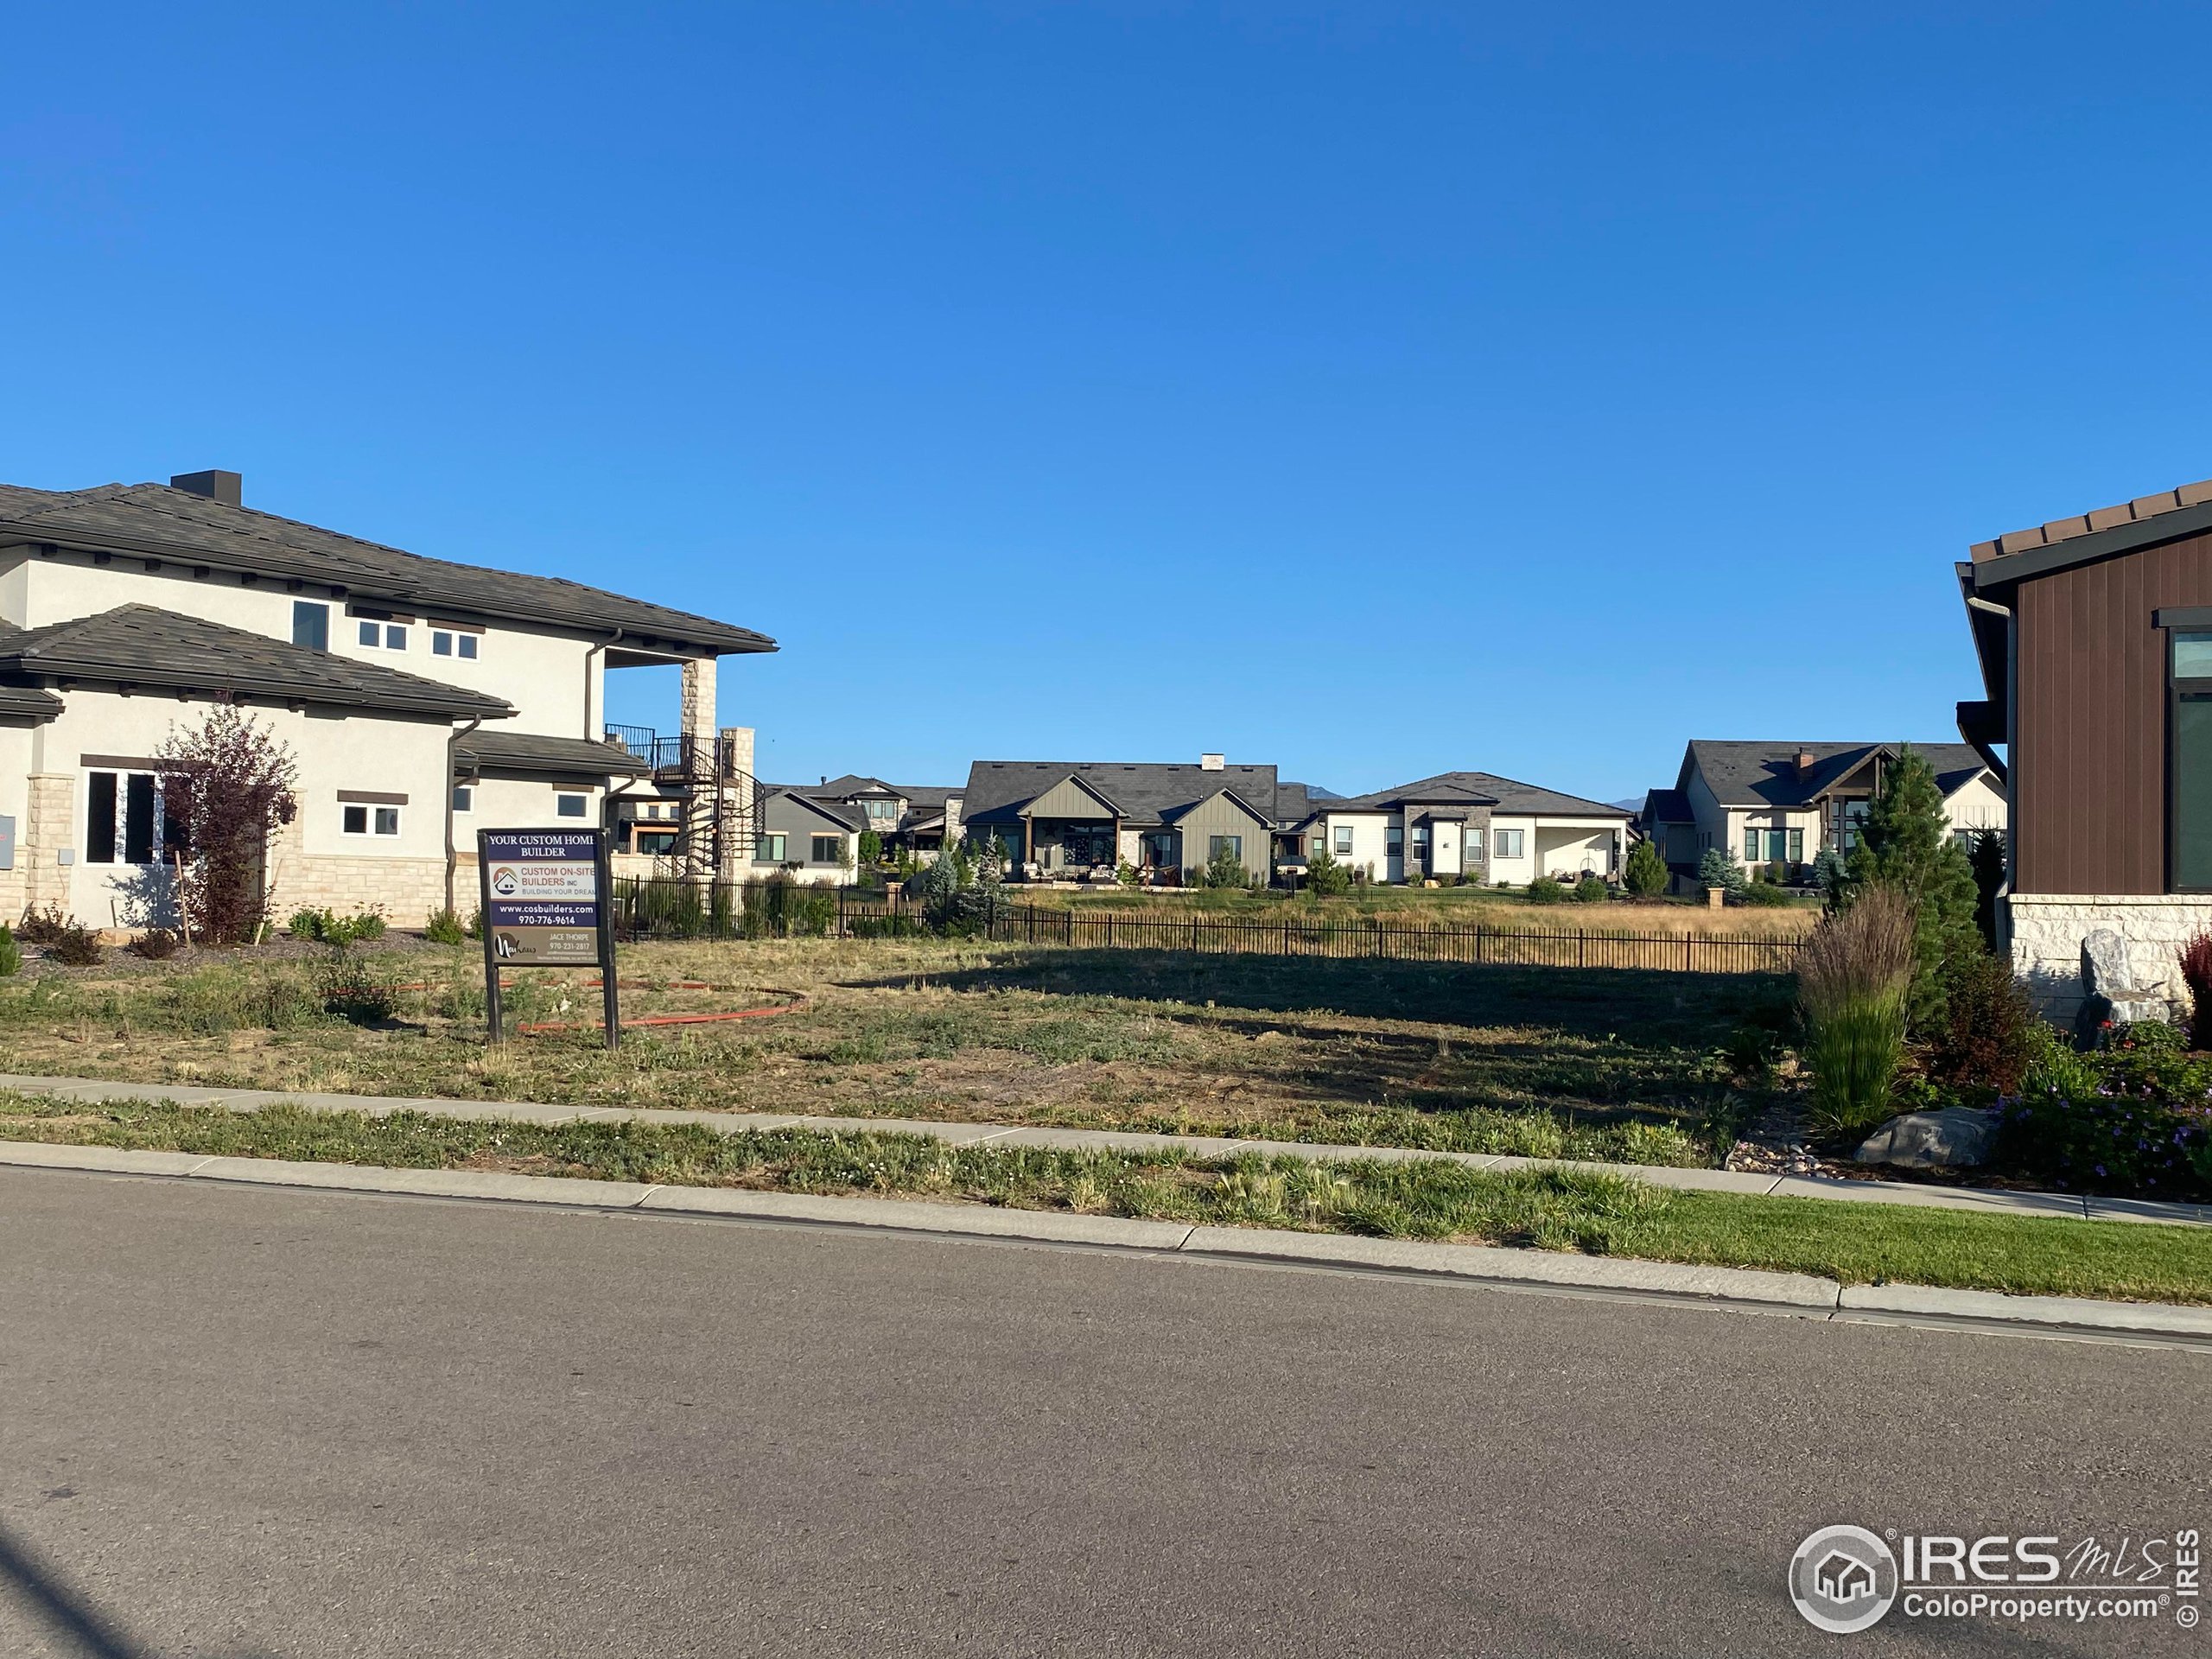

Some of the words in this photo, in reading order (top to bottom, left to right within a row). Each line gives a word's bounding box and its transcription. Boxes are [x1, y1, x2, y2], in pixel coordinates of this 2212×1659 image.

[490, 836, 517, 845] YOUR
[519, 836, 563, 845] CUSTOM
[521, 848, 566, 856] BUILDER
[521, 868, 557, 876] CUSTOM
[560, 868, 595, 876] ON-SITE
[499, 904, 594, 913] www.cosbuilders.com
[518, 916, 575, 925] 970-776-9614
